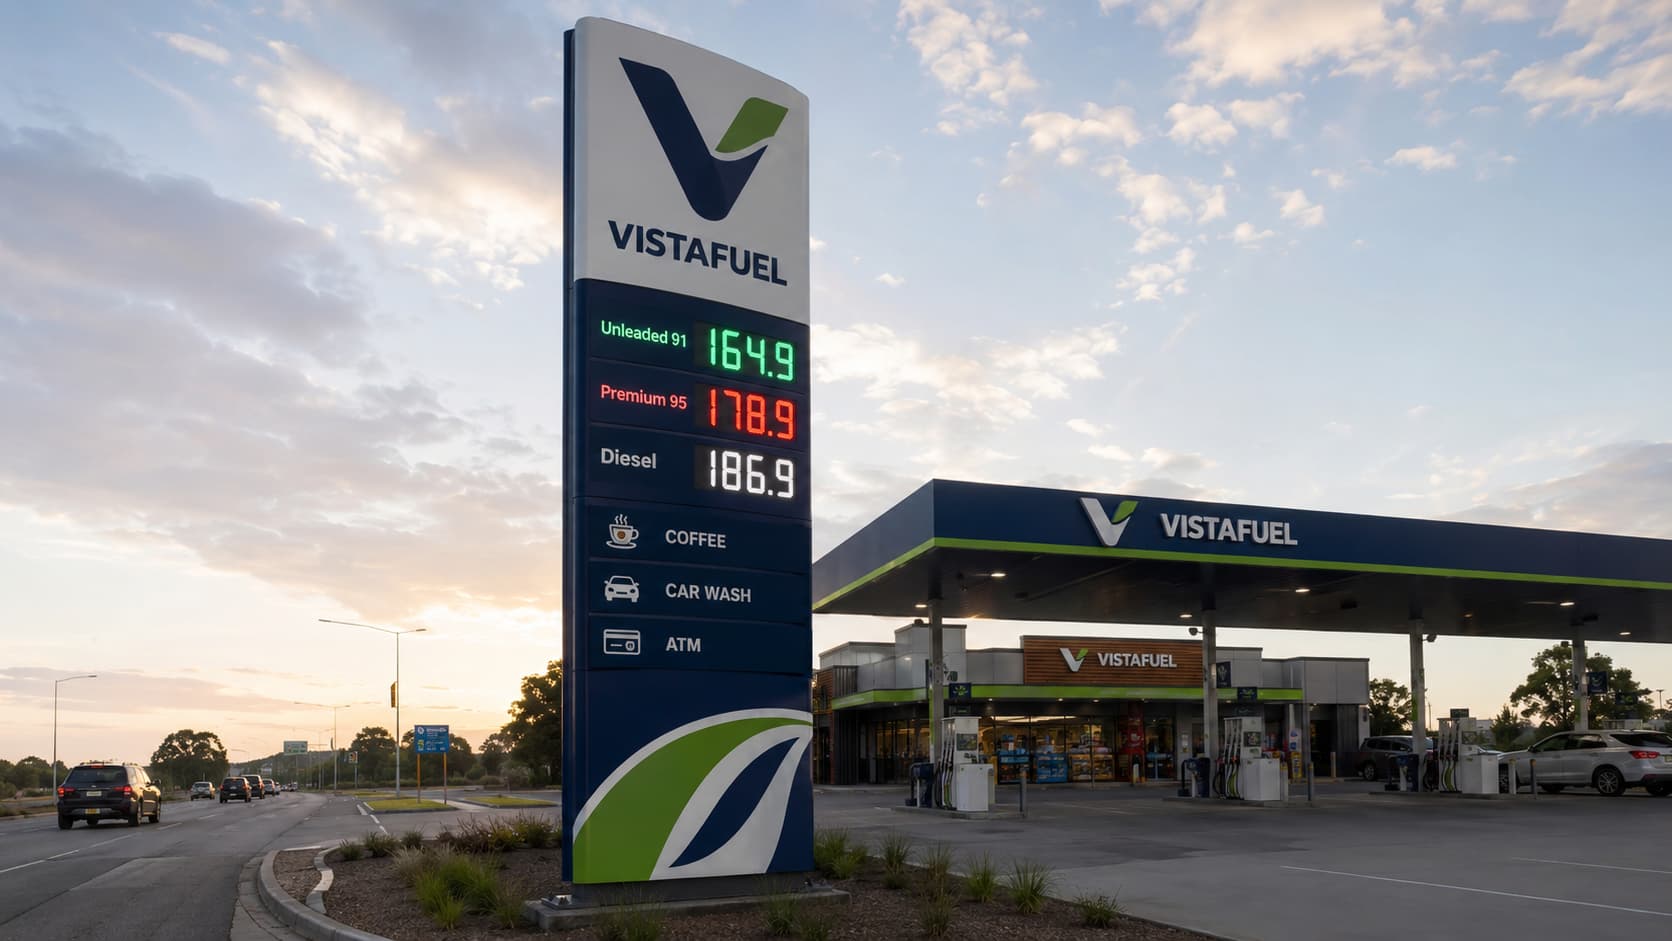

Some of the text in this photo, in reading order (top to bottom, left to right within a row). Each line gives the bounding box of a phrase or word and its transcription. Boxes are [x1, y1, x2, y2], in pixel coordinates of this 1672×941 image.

[608, 220, 788, 286] VISTAFUEL
[601, 320, 687, 348] Unleaded 91
[710, 327, 793, 381] 164.9
[601, 384, 688, 410] Premium 95
[710, 388, 794, 440] 178.9
[601, 447, 657, 470] Diesel
[710, 450, 794, 498] 186.9
[665, 529, 727, 549] COFFEE
[1160, 512, 1299, 546] VISTAFUEL
[665, 583, 752, 603] CAR WASH
[665, 636, 701, 652] ATM
[1097, 652, 1177, 668] VISTAFUEL
